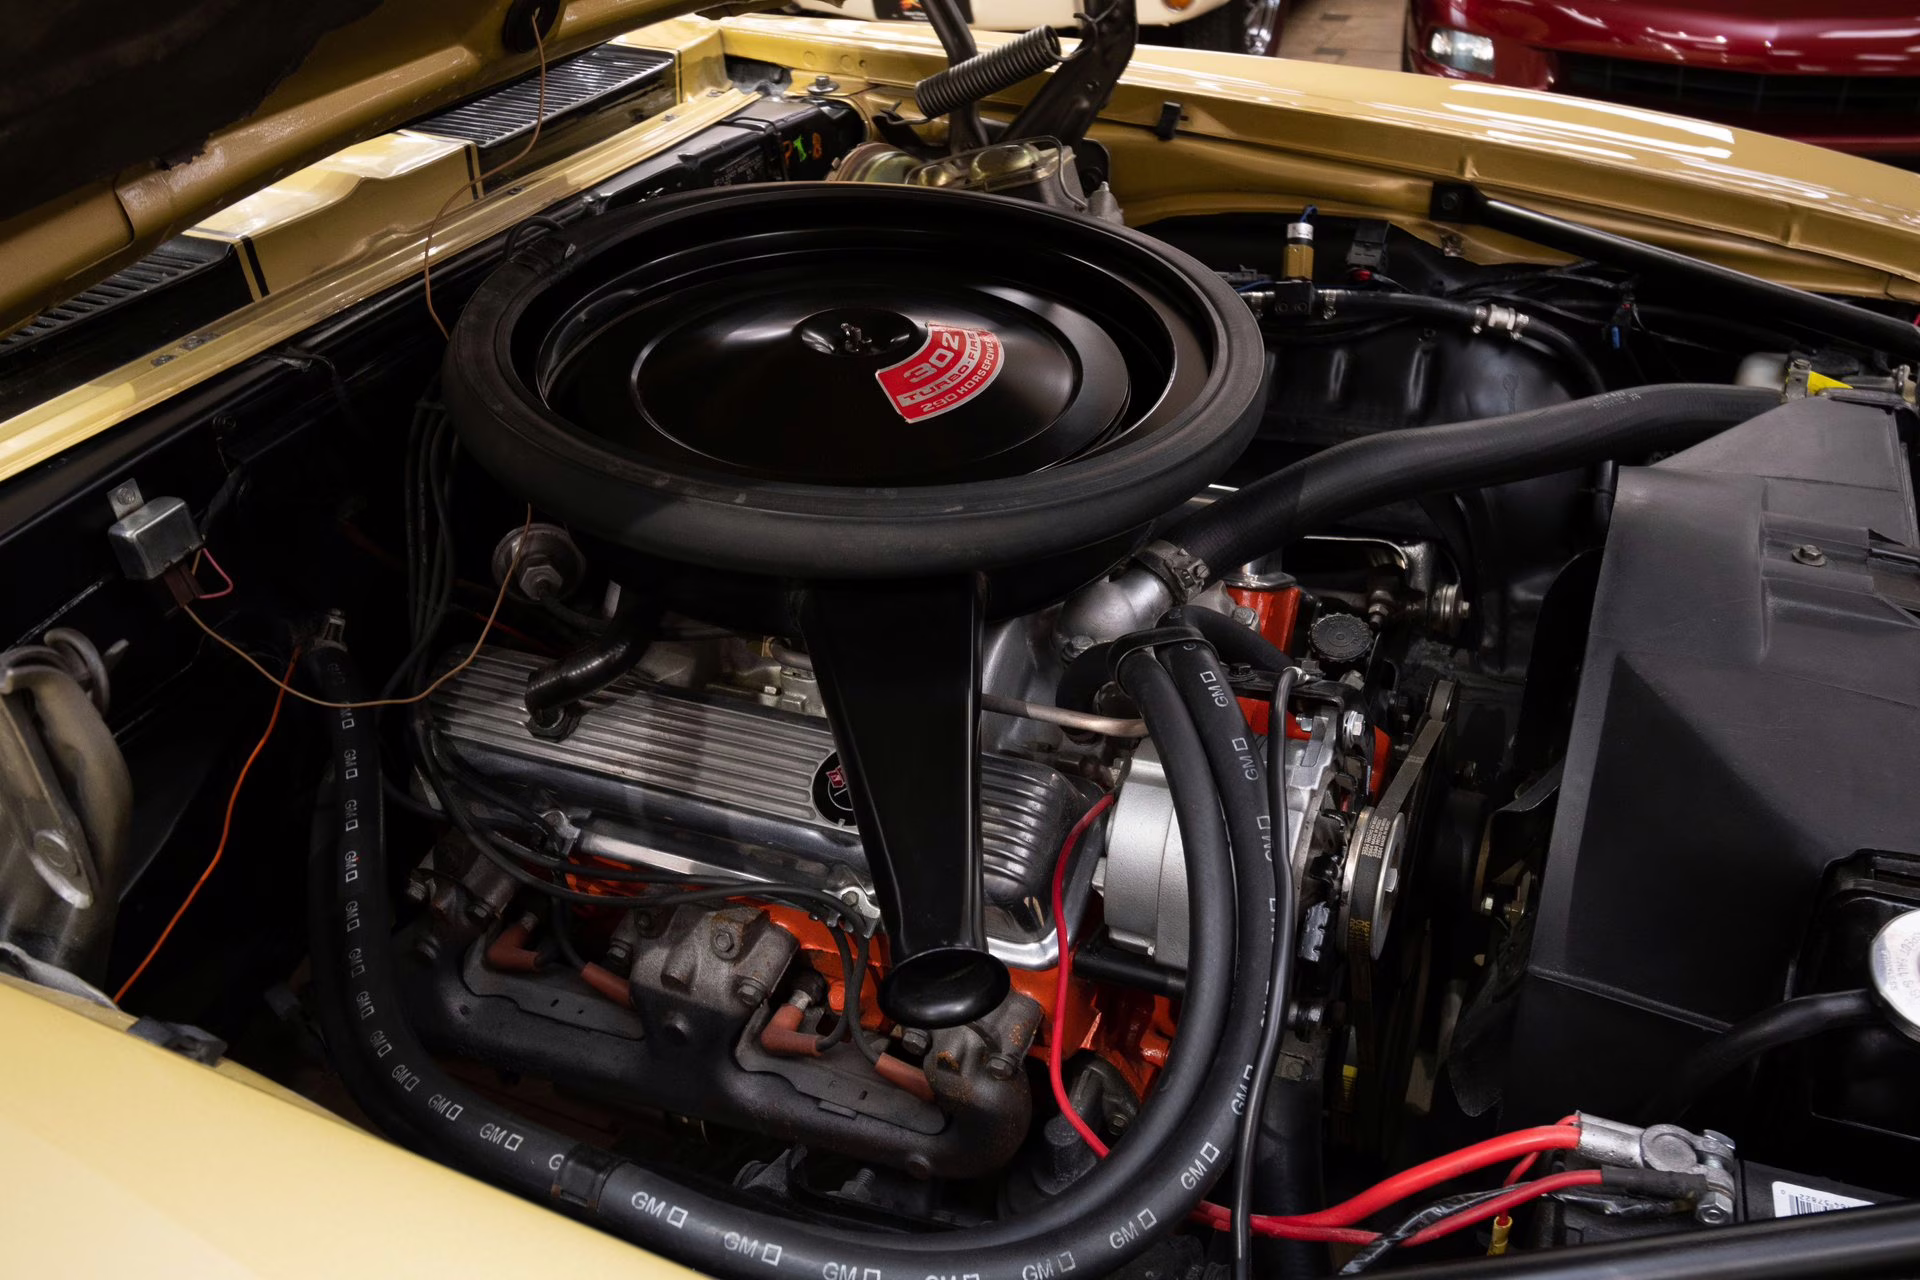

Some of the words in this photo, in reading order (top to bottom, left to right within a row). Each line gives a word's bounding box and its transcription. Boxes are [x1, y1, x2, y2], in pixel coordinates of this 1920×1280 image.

[903, 332, 960, 383] 302
[903, 332, 978, 402] TURBO-FIRE
[921, 393, 958, 413] 290
[957, 337, 995, 395] HORSEPOWE
[1208, 685, 1229, 708] GM
[1239, 755, 1259, 781] GM
[344, 850, 358, 871] GM
[346, 900, 359, 920] GM
[357, 991, 371, 1008] GM
[370, 1030, 386, 1048] GM
[391, 1064, 411, 1085] GM
[428, 1093, 451, 1114] GM
[479, 1123, 506, 1145] GM
[549, 1154, 565, 1171] G
[1181, 1163, 1208, 1190] GM
[631, 1192, 665, 1218] GM
[724, 1232, 758, 1258] GM
[1109, 1221, 1139, 1250] GM
[822, 1261, 858, 1280] GM
[1022, 1258, 1055, 1280] GM
